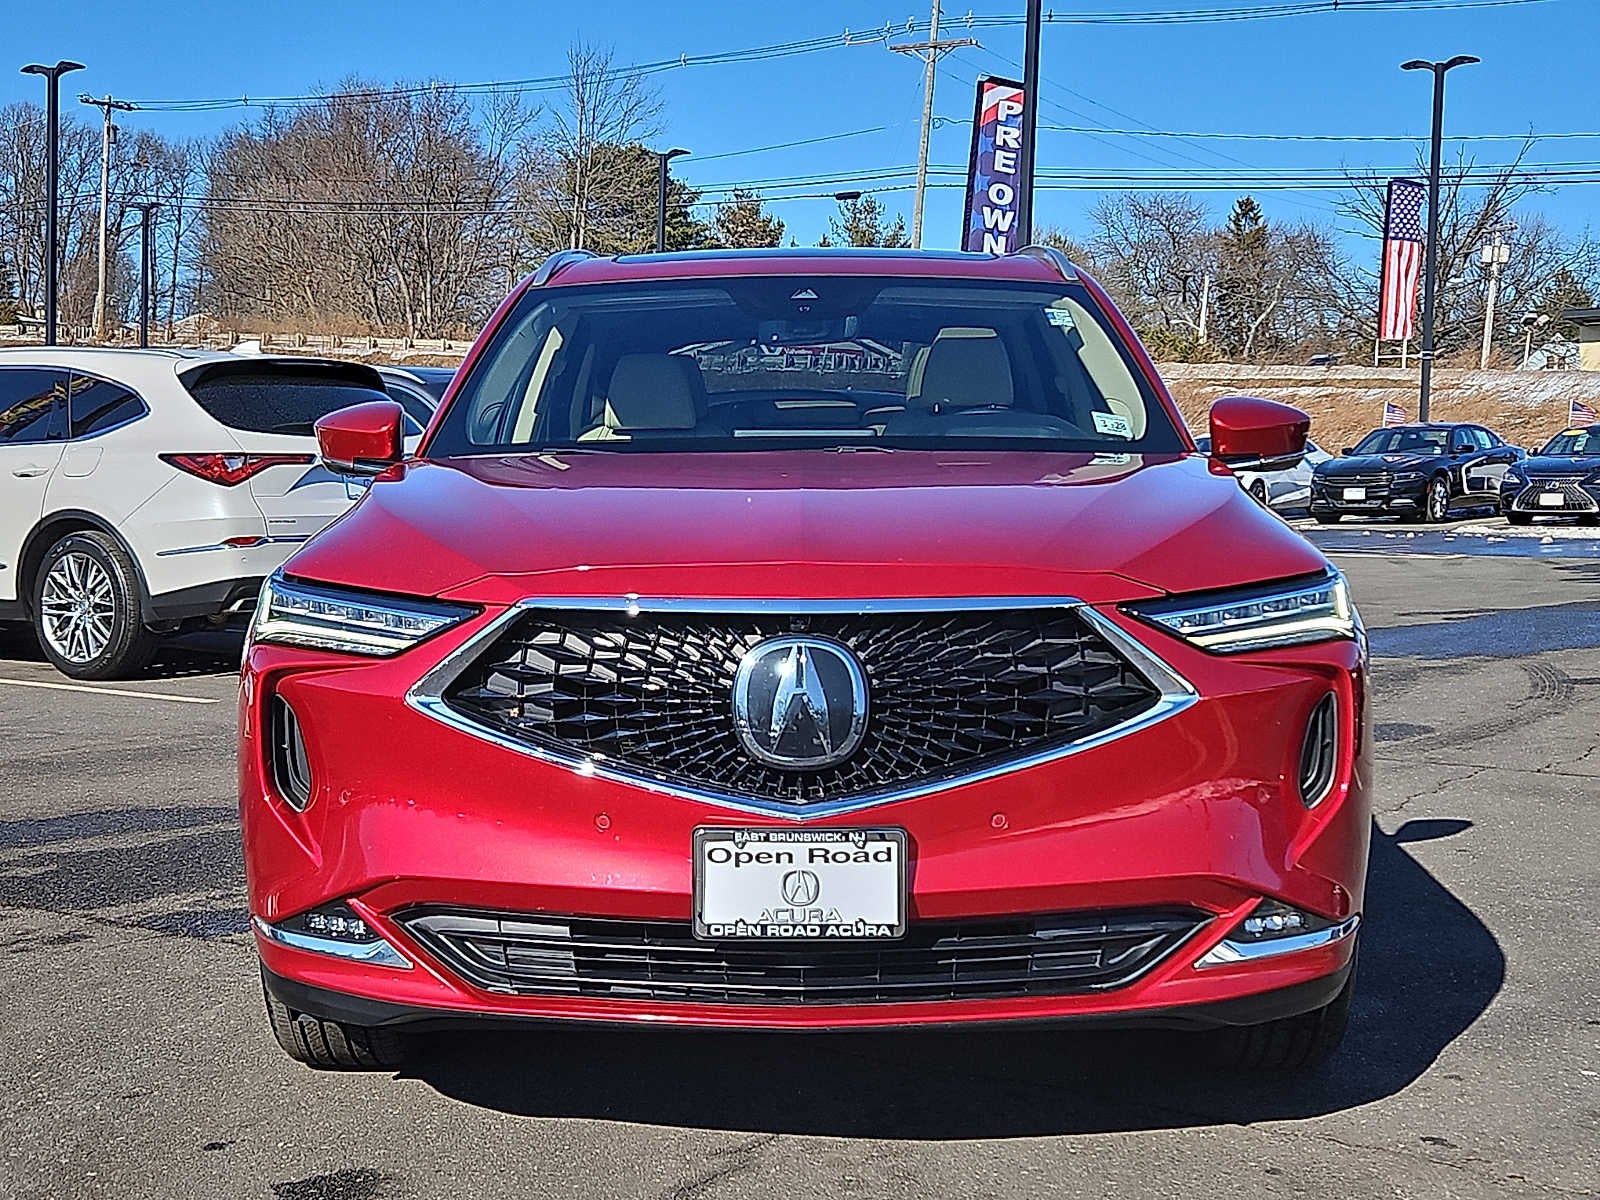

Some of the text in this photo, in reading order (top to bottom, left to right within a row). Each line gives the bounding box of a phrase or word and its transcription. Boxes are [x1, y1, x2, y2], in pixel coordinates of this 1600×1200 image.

[993, 99, 1023, 174] PRE
[734, 831, 767, 842] EAST
[848, 831, 866, 842] NJ
[707, 846, 892, 868] Open Road
[758, 908, 843, 923] ACURA
[710, 924, 892, 937] OPEN ROAD ACURA
